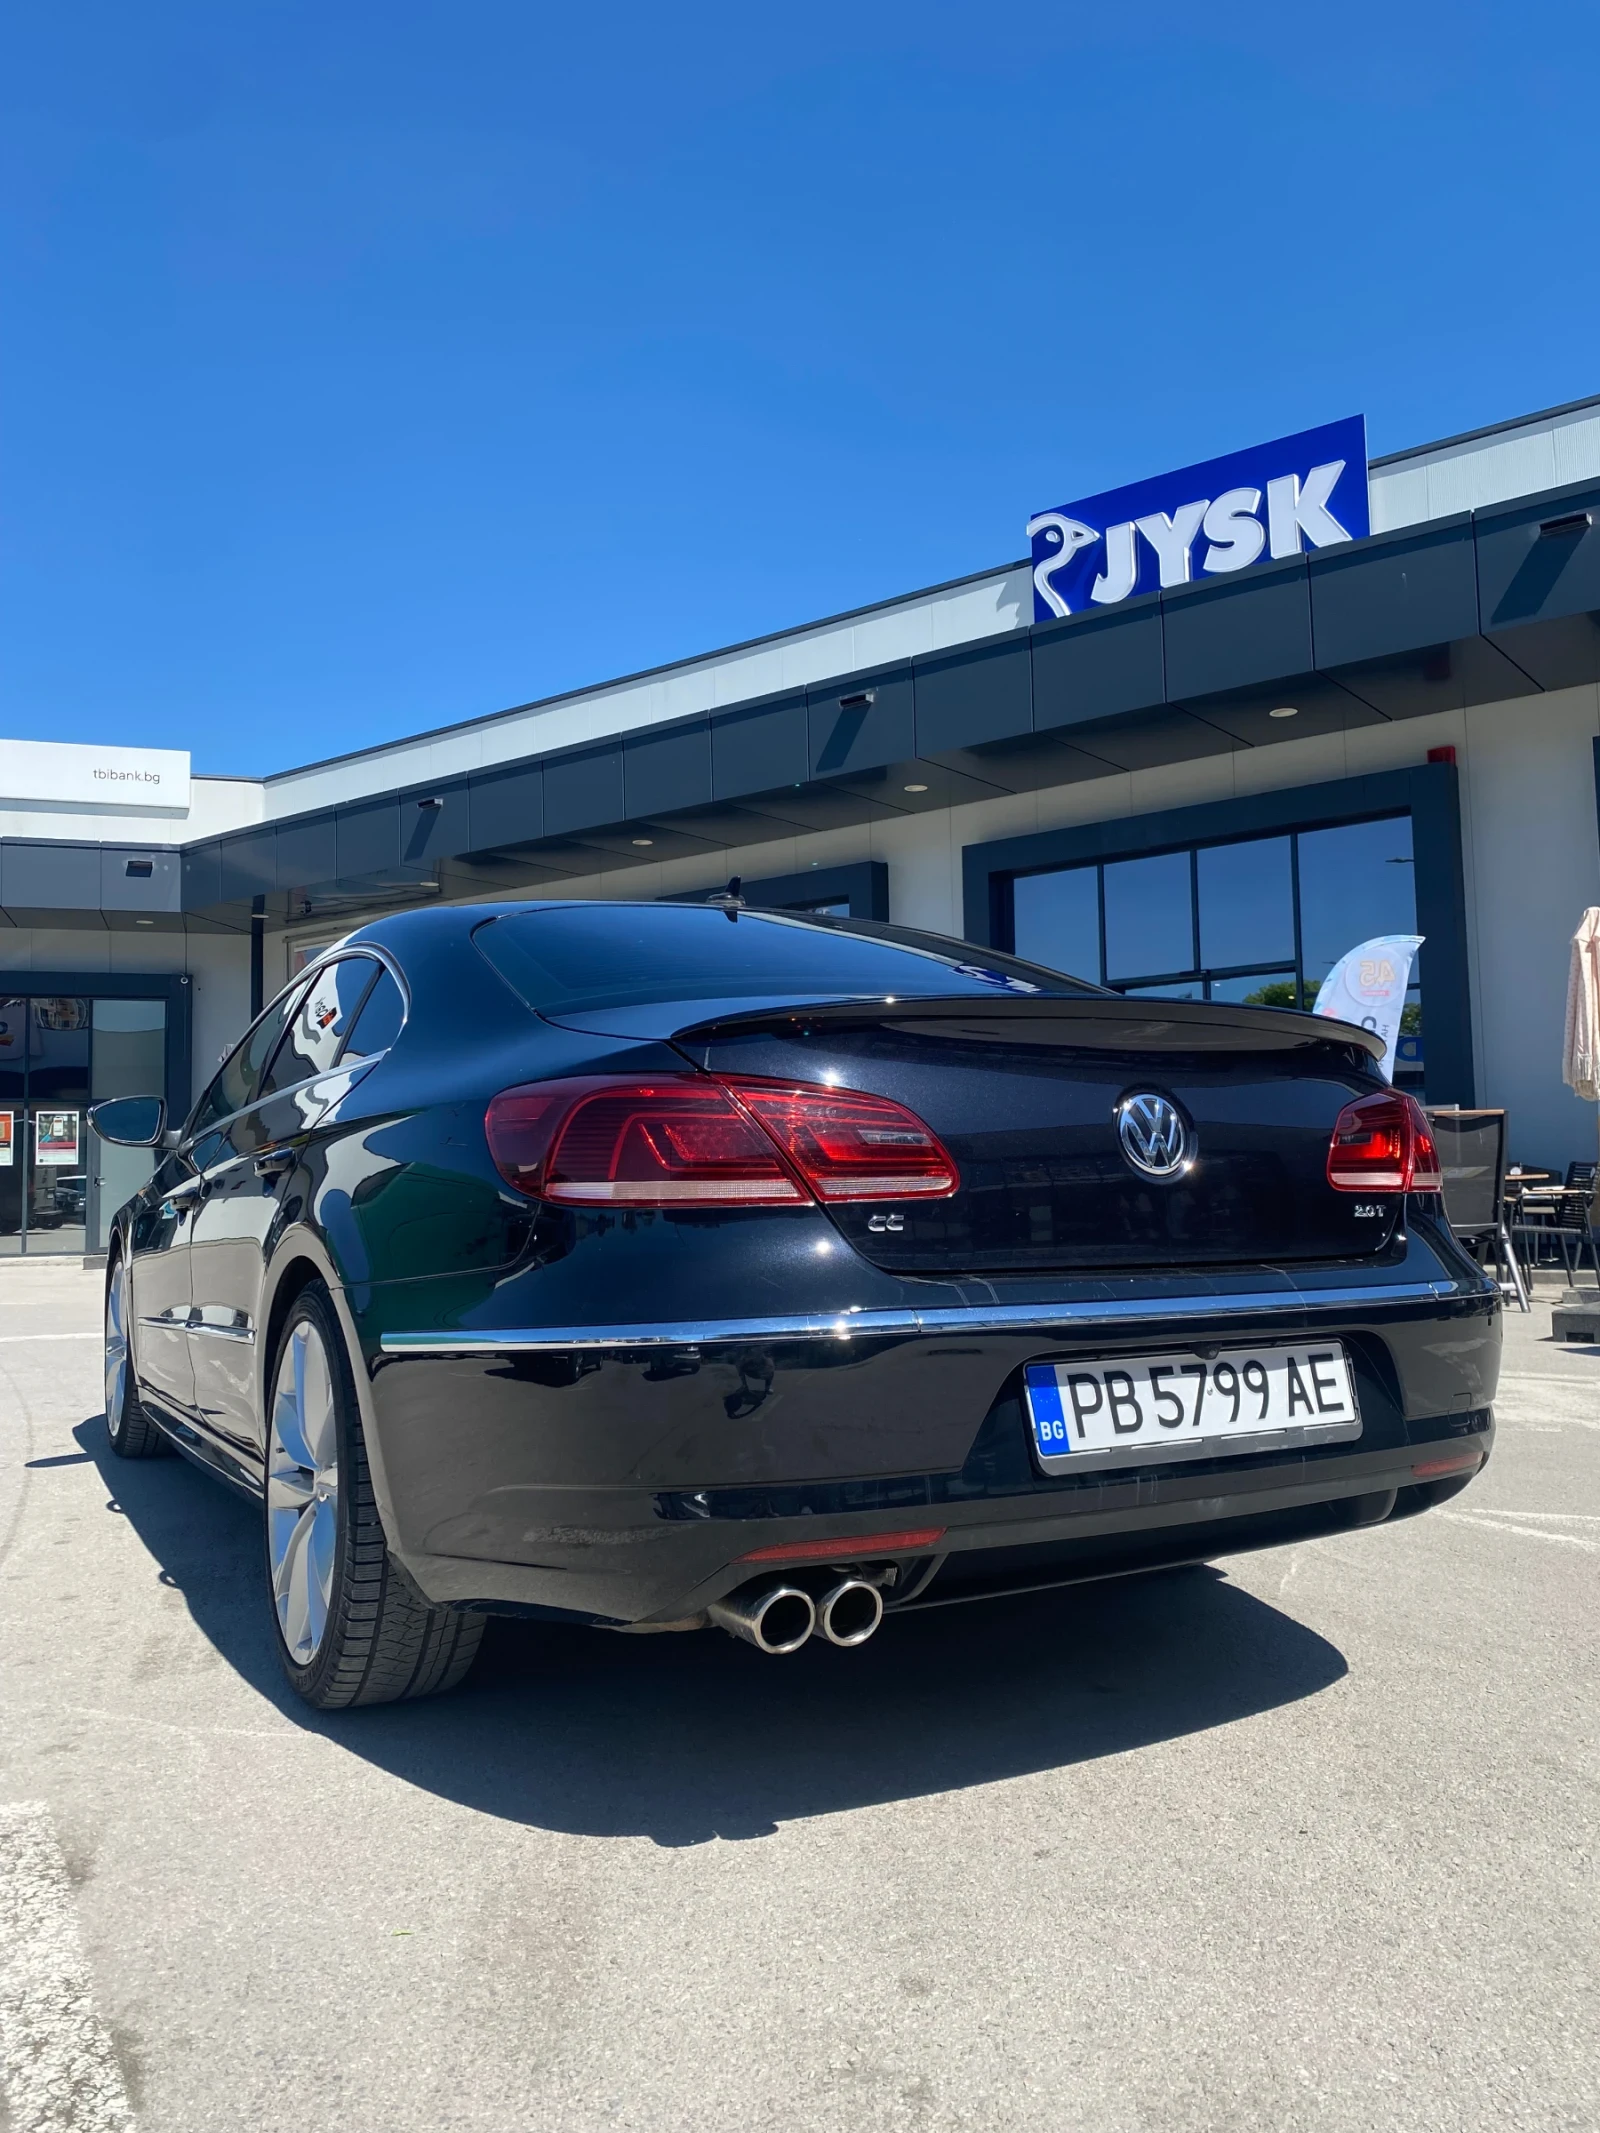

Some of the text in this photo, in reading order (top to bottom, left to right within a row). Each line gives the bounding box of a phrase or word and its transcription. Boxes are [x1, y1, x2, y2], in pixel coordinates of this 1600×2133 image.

[1090, 459, 1353, 604] JYSK
[93, 768, 160, 785] tbibank.bg
[868, 1214, 904, 1232] CC
[1286, 1353, 1345, 1418] AE
[1040, 1420, 1065, 1442] BG
